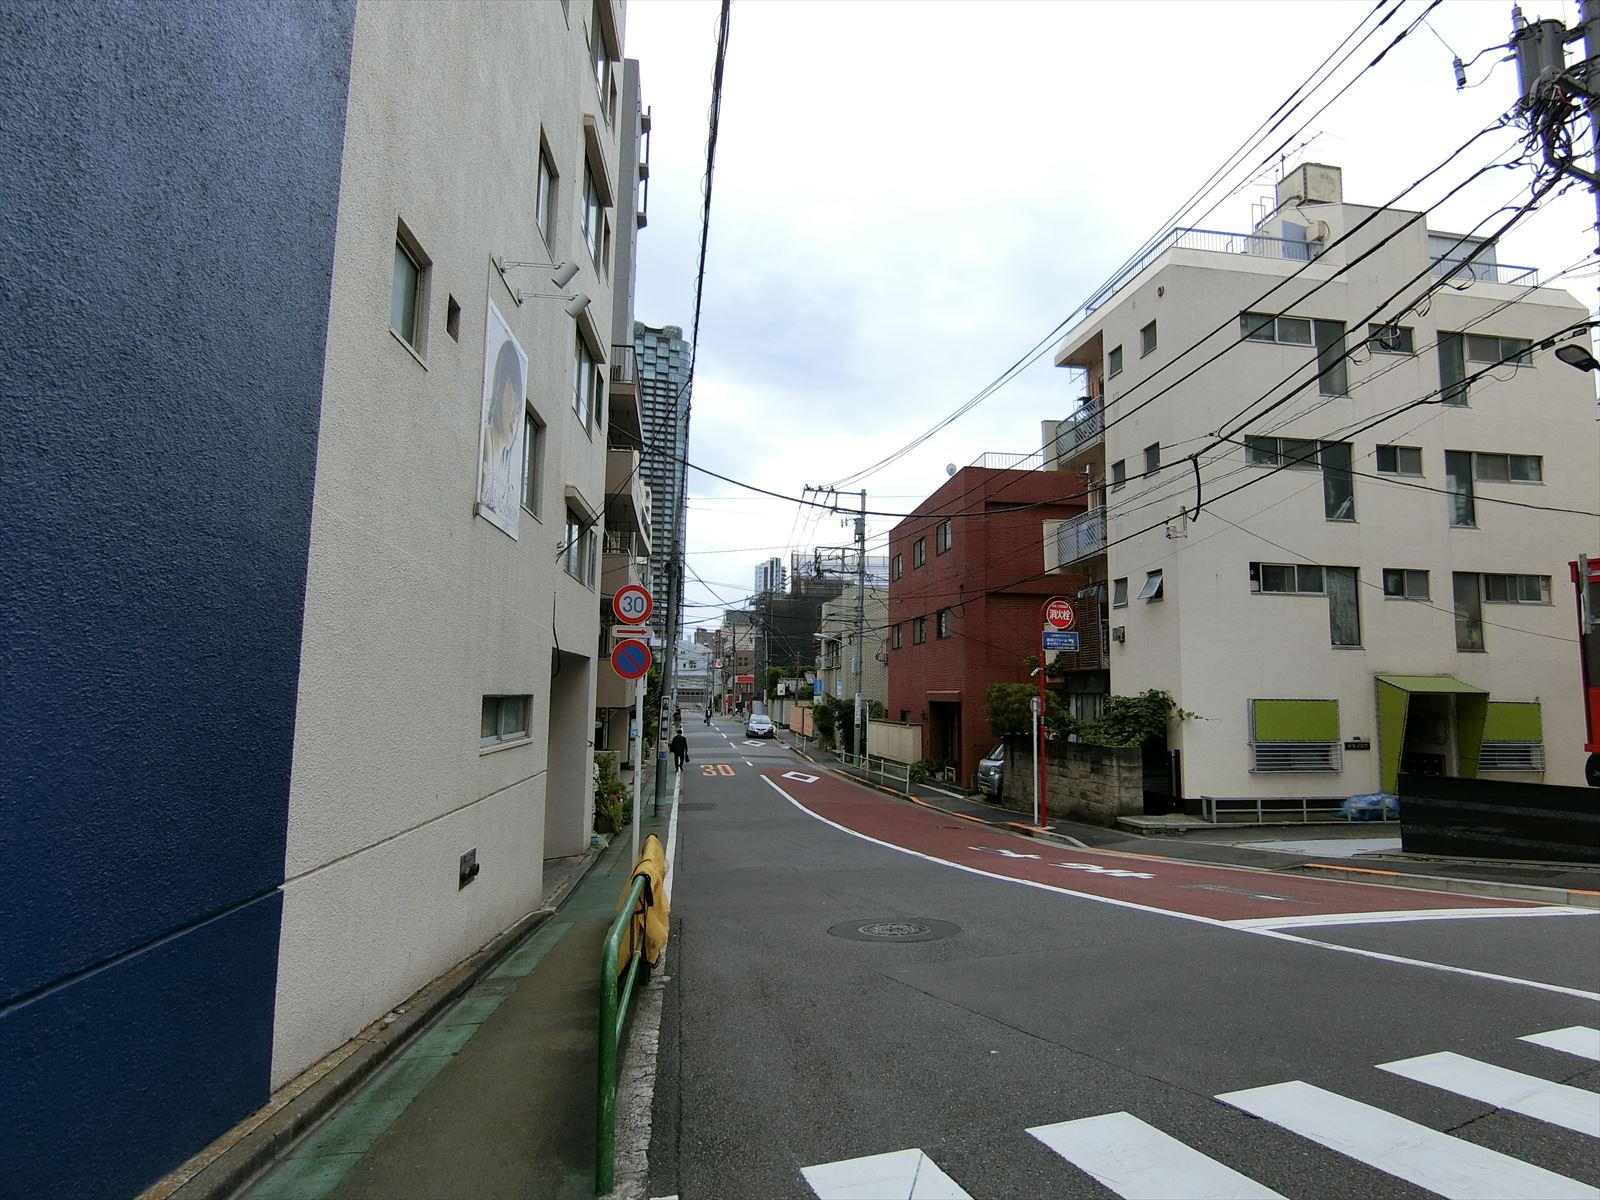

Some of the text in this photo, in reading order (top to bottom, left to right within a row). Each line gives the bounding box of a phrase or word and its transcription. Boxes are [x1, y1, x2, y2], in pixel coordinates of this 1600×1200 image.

[622, 596, 644, 613] 30
[1049, 609, 1071, 620] 消火栓
[699, 764, 736, 776] 30
